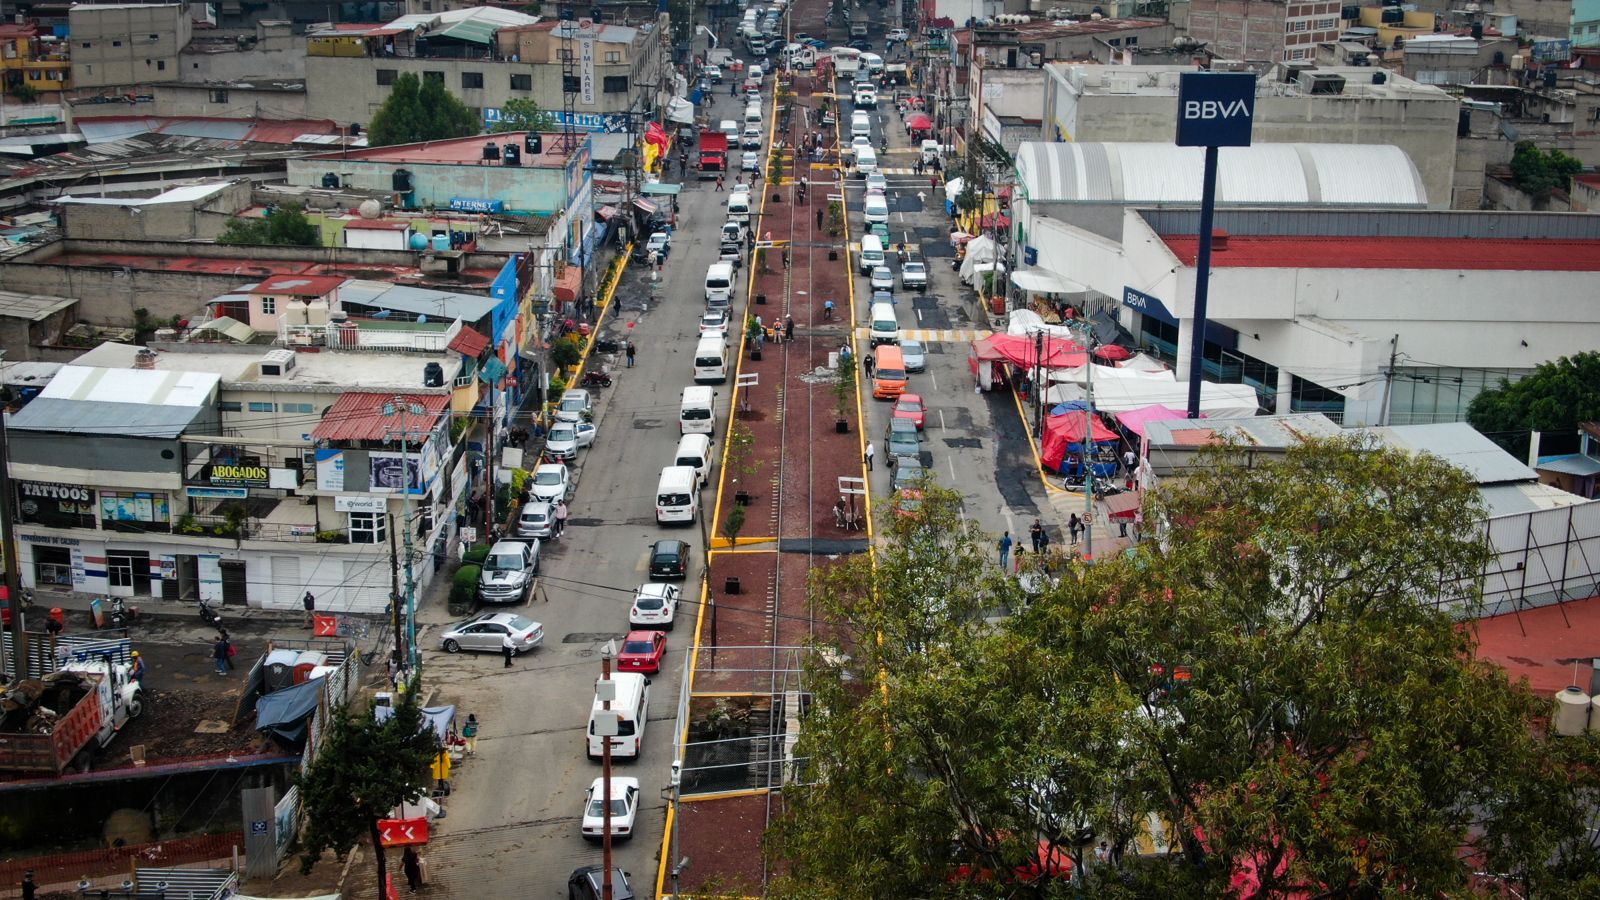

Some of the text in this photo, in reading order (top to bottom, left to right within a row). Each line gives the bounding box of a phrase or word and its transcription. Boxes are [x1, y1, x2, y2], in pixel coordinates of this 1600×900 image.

[583, 41, 592, 101] SIMILARES
[1184, 98, 1250, 119] BBVA
[453, 199, 493, 209] INTERNET
[1127, 291, 1147, 309] BBVA
[211, 465, 267, 480] ABOGADOS
[22, 483, 90, 501] TATTOOS
